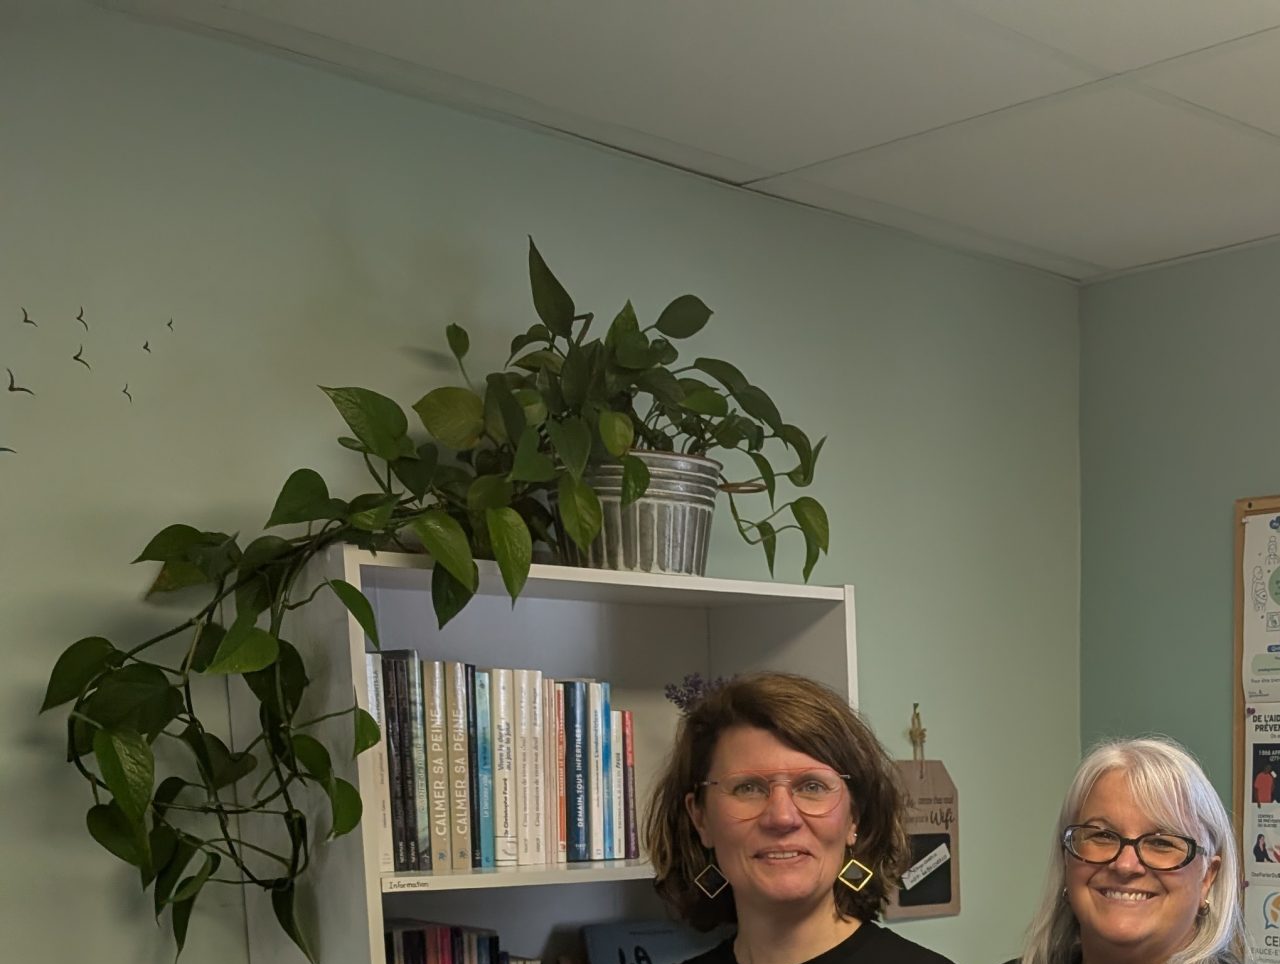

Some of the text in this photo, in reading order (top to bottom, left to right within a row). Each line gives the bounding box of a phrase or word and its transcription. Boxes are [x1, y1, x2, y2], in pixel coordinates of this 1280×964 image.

[1252, 715, 1263, 723] DE
[430, 709, 447, 836] CALMER SA PEINE
[452, 709, 468, 834] CALMER SA PEINE
[577, 794, 585, 828] DEMAIN,
[930, 808, 955, 830] Wifi
